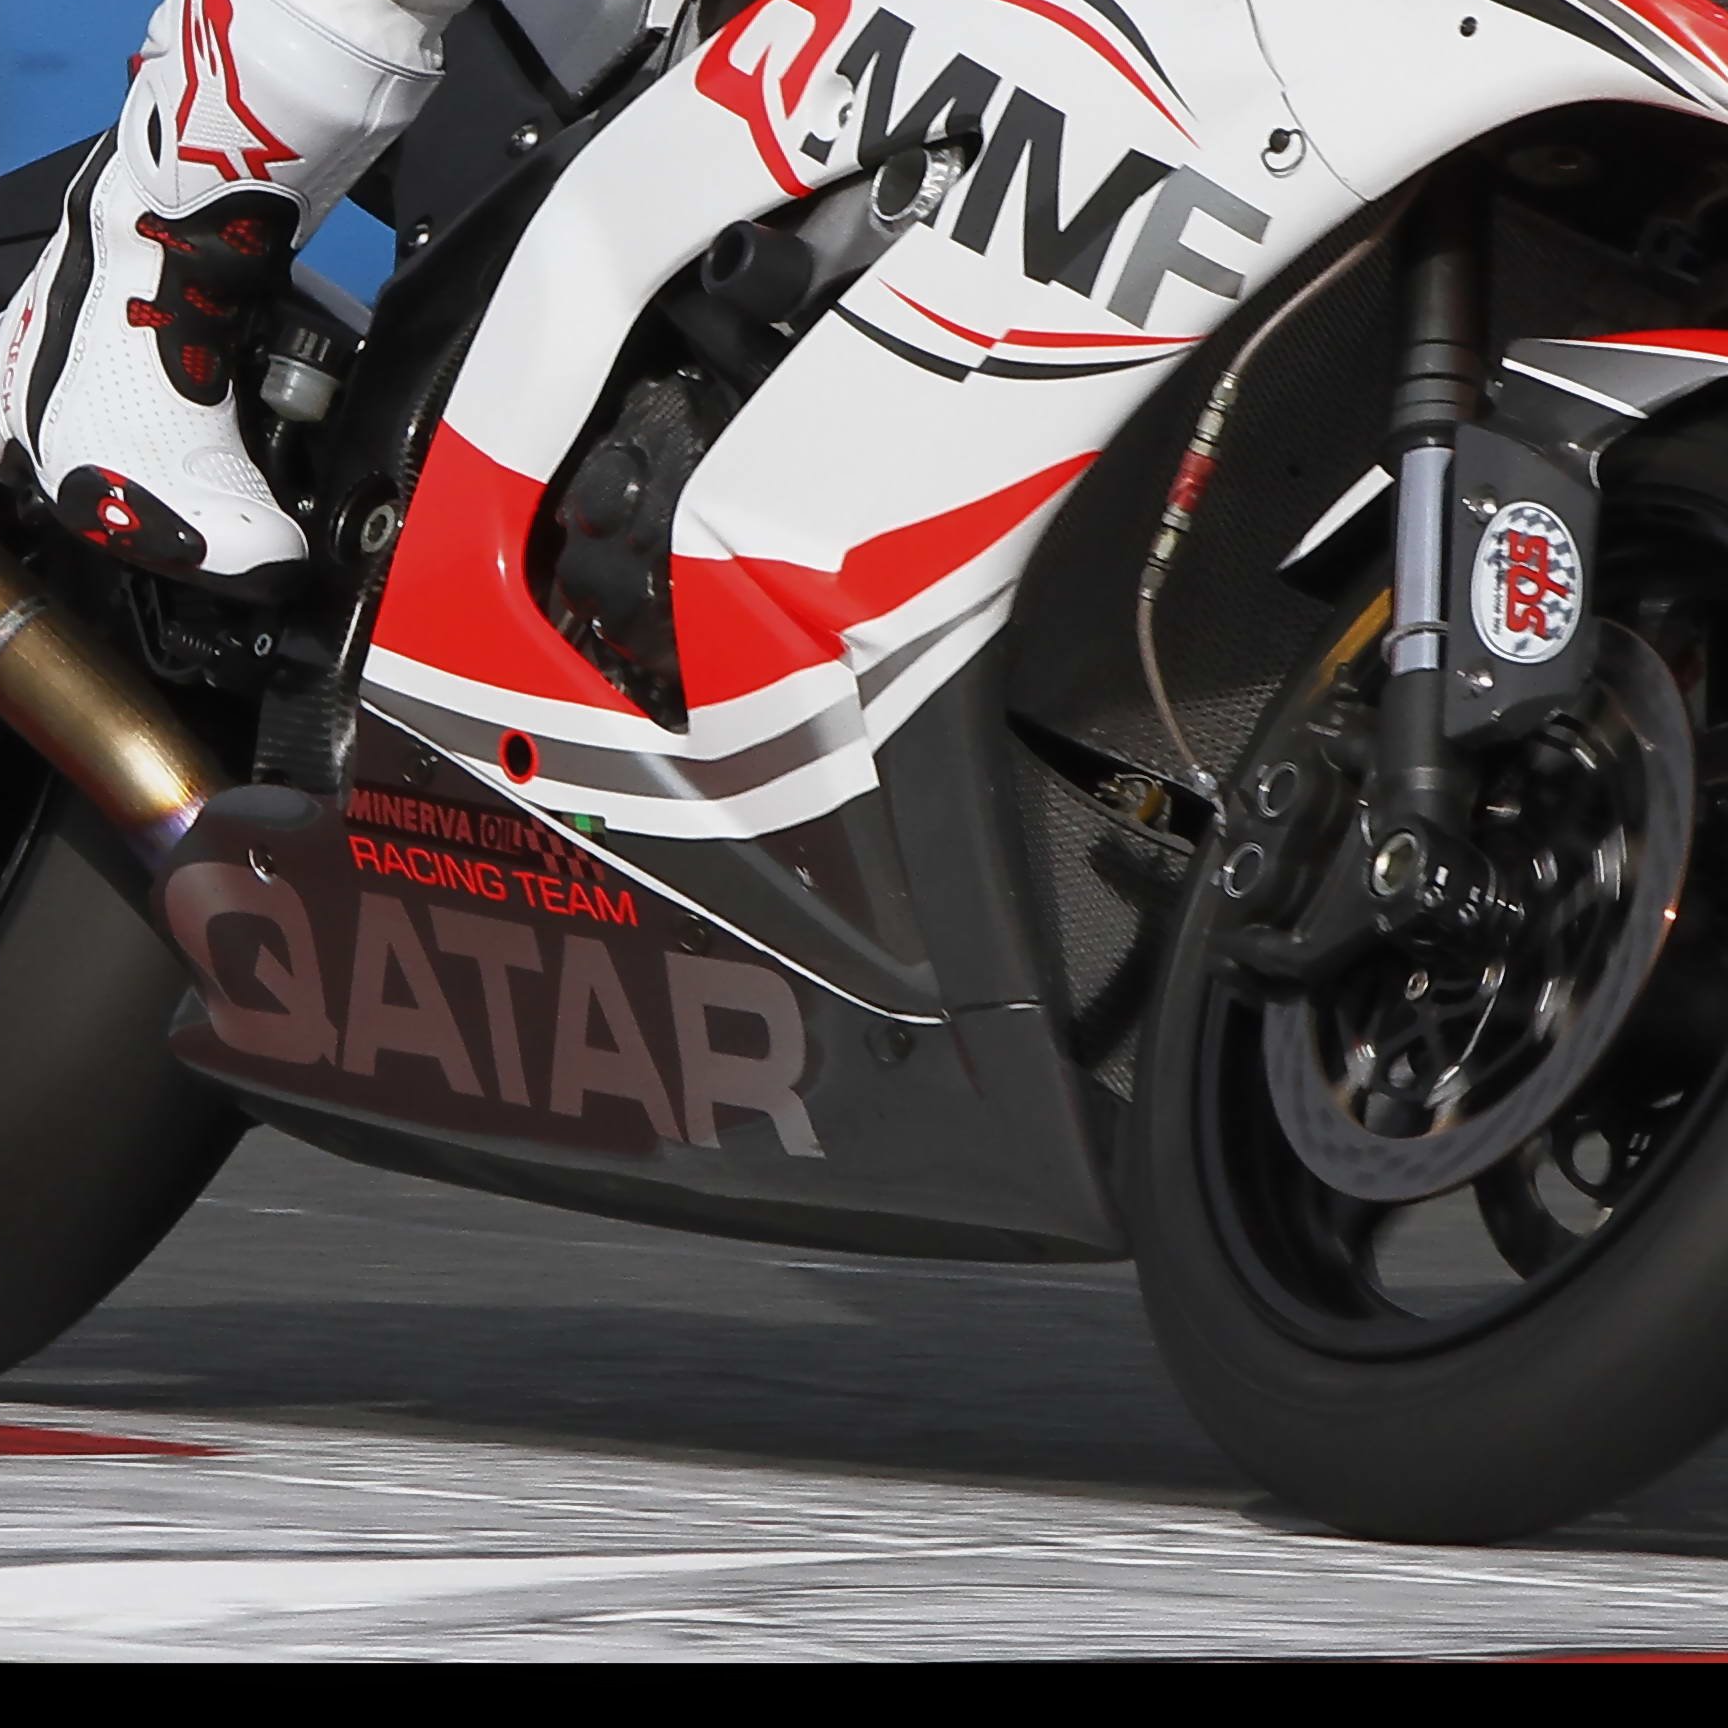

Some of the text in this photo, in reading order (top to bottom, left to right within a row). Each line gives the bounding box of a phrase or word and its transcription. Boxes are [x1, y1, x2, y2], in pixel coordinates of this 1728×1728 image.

[345, 787, 474, 846] MINERVA
[347, 834, 640, 928] RACING TEAM
[164, 860, 827, 1159] QATAR
